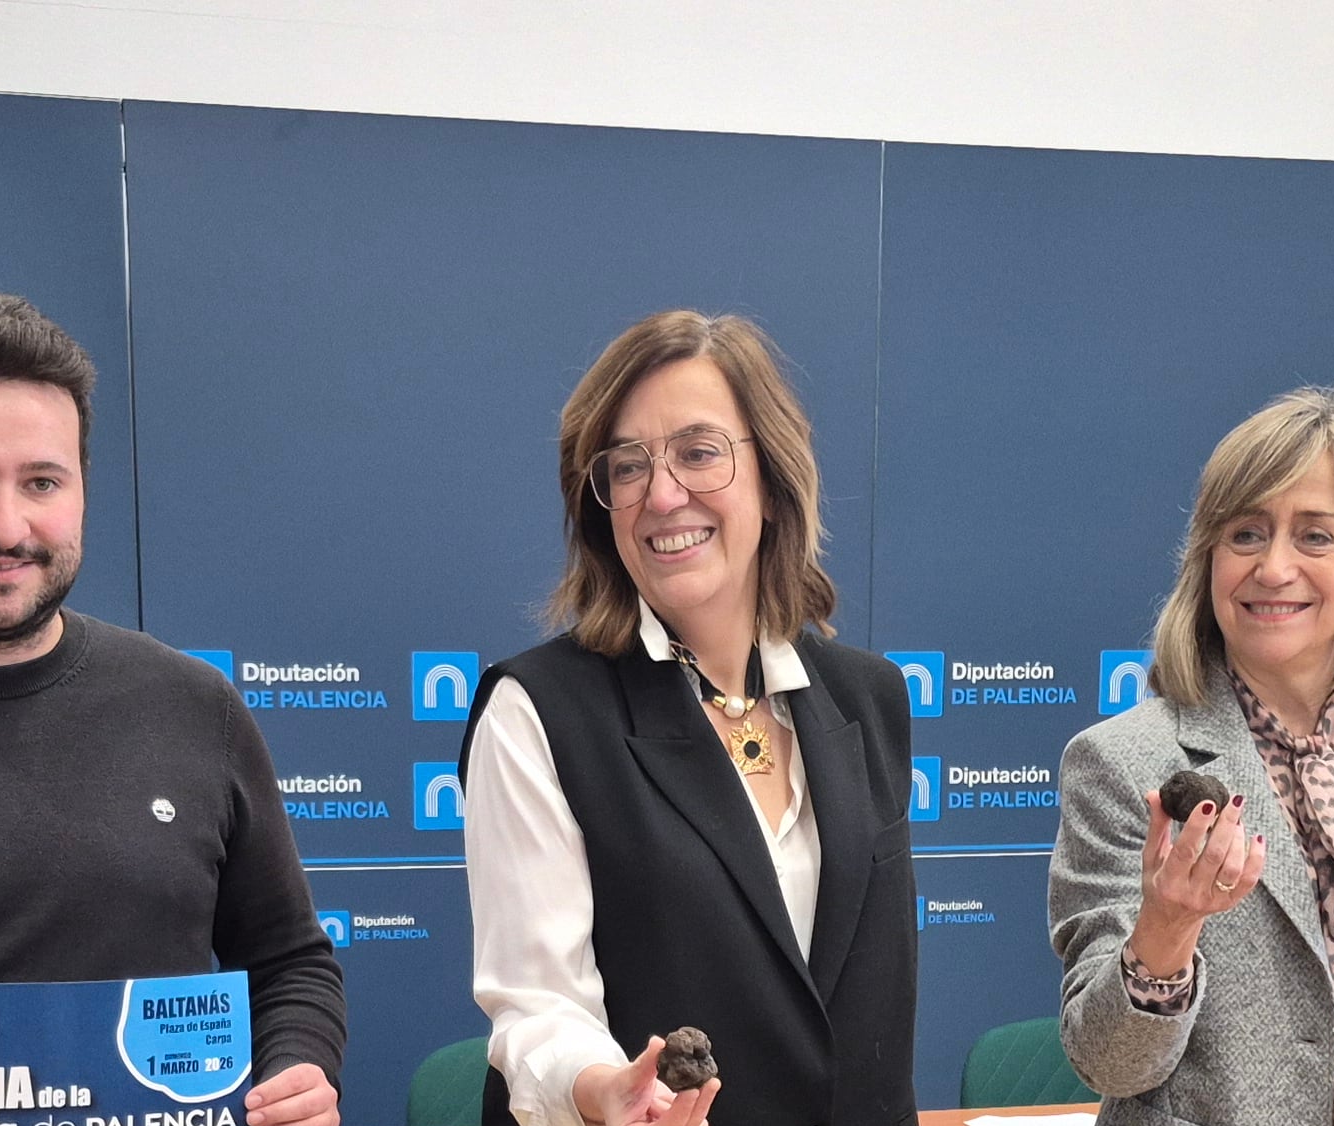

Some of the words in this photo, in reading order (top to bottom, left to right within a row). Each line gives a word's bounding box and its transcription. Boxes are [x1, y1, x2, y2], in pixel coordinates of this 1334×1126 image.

[242, 662, 360, 686] Diputación
[952, 661, 1054, 684] Diputación
[243, 690, 274, 709] DE
[280, 690, 388, 709] PALENCIA
[951, 688, 978, 704] DE
[983, 687, 1077, 704] PALENCIA
[948, 766, 1050, 788] Diputación
[948, 792, 974, 809] DE
[283, 801, 390, 819] PALENCIA
[928, 900, 983, 913] Diputación
[354, 915, 415, 928] Diputación
[928, 913, 943, 923] DE
[945, 912, 995, 922] PALENCIA
[354, 929, 370, 940] DE
[373, 928, 429, 940] PALENCIA
[143, 989, 230, 1020] BALTANÁS
[159, 1023, 185, 1034] Plaza
[186, 1022, 198, 1032] de
[200, 1018, 231, 1031] España
[205, 1034, 232, 1045] Carpa
[147, 1055, 156, 1076] 1
[160, 1060, 199, 1075] MARZO
[204, 1056, 233, 1072] 2026
[38, 1086, 66, 1108] de
[70, 1085, 92, 1107] la
